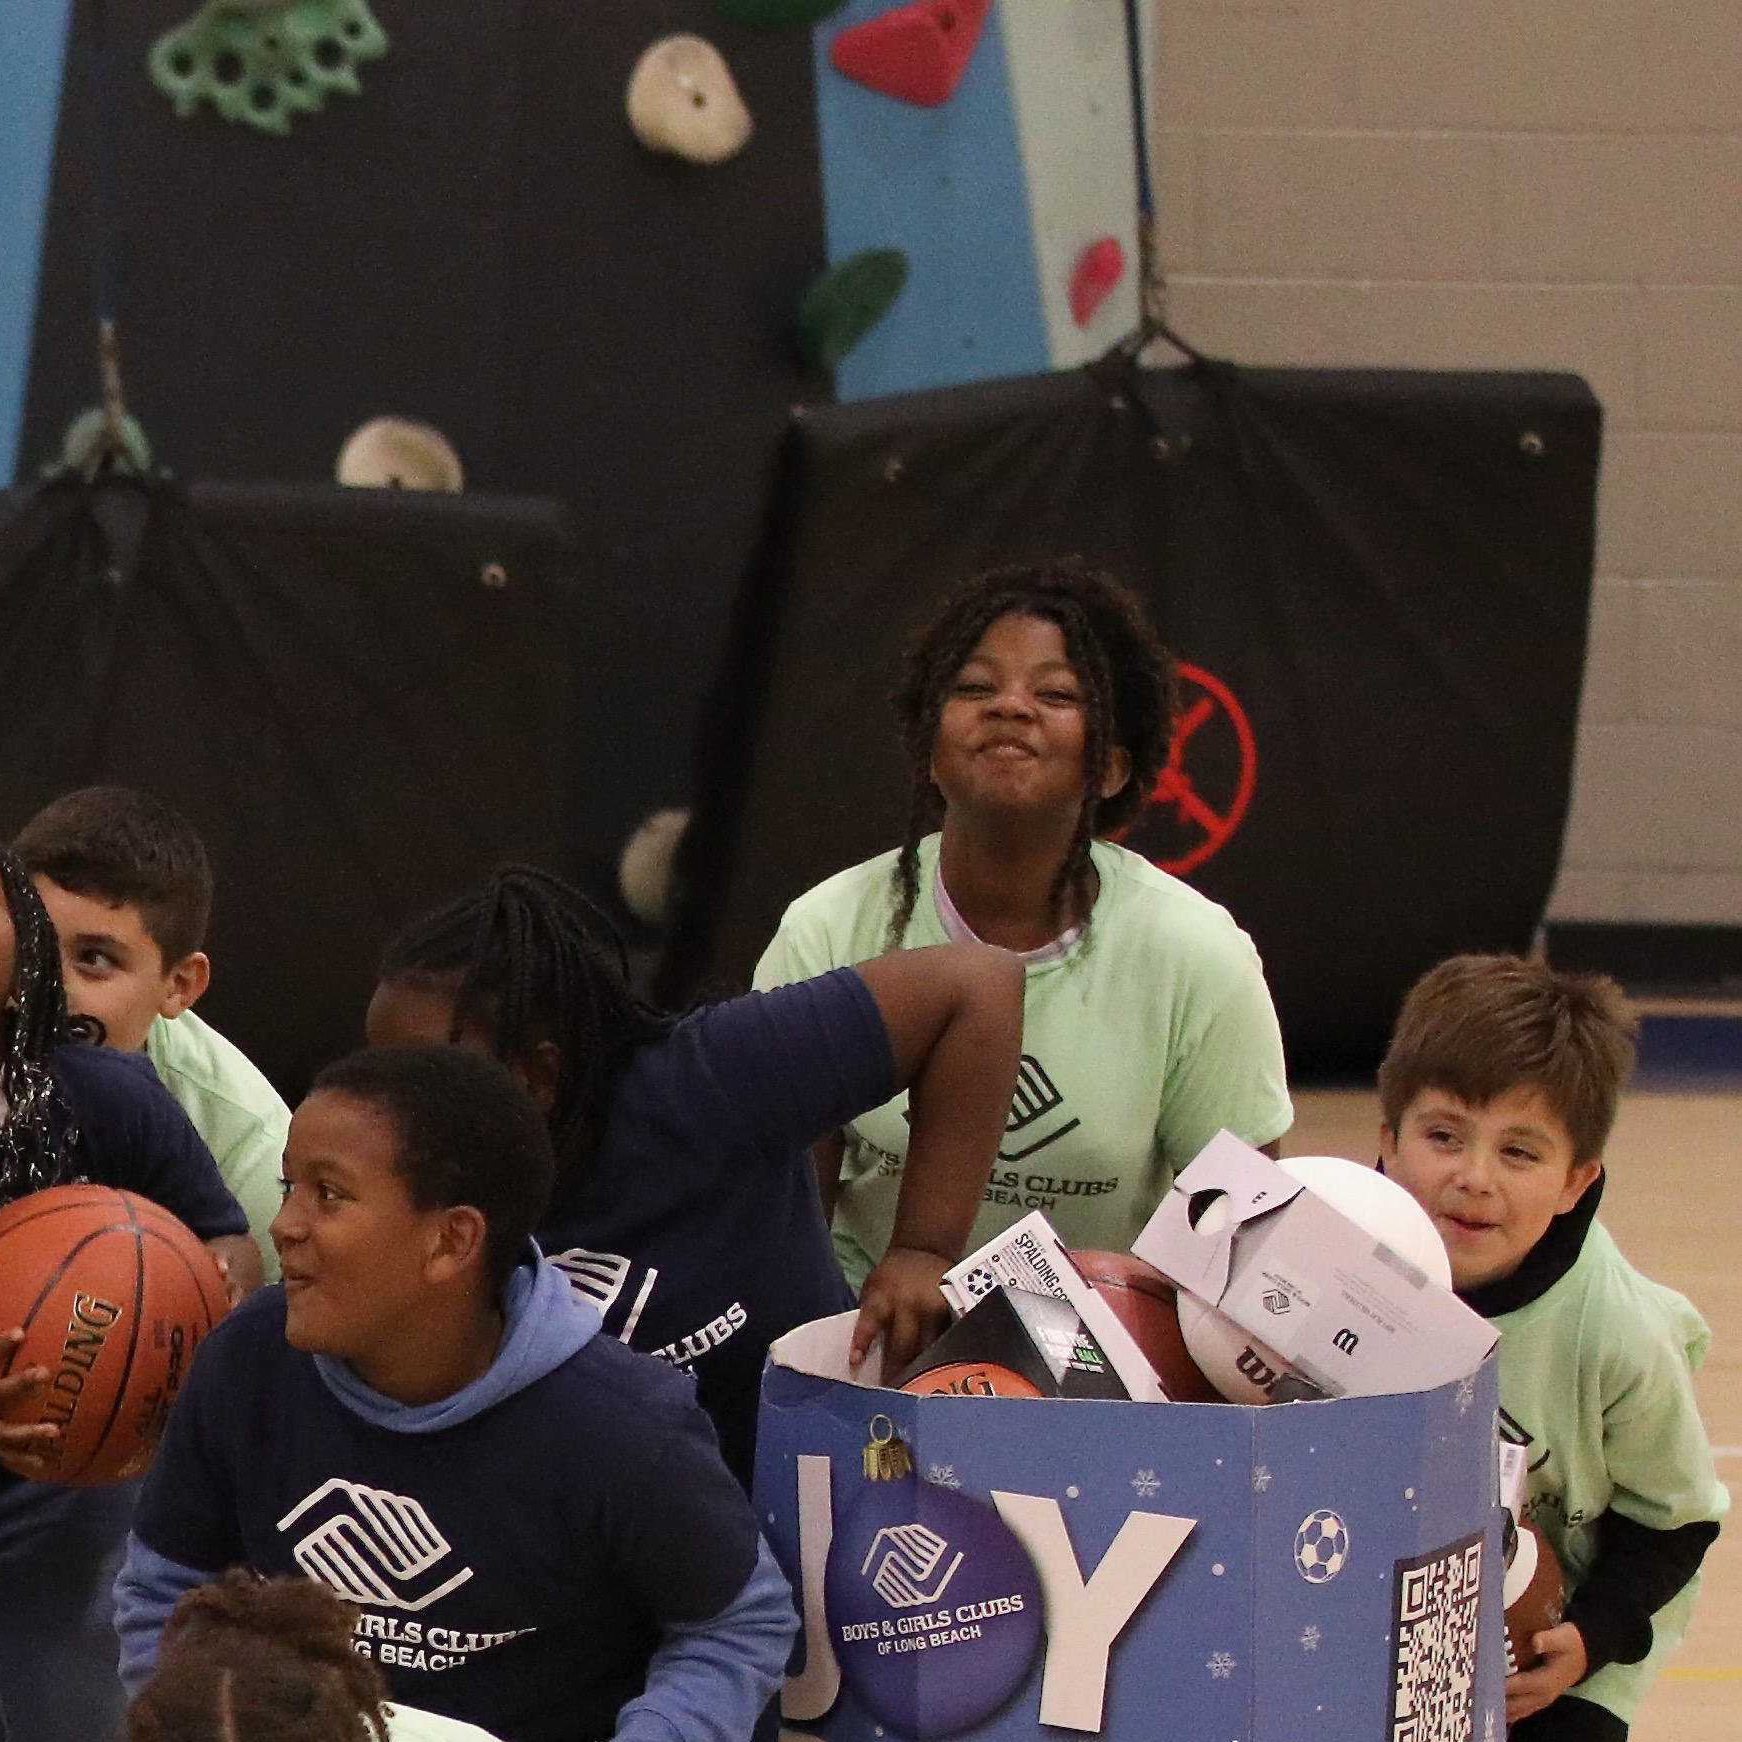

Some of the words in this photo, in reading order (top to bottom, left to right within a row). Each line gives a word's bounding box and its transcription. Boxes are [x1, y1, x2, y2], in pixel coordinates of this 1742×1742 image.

[352, 1612, 423, 1645] IRLS
[841, 1620, 880, 1642] BOYS
[881, 1619, 896, 1637] &
[896, 1609, 952, 1636] GIRLS
[955, 1594, 1024, 1624] CLUBS
[877, 1640, 893, 1656] OF
[894, 1636, 927, 1653] LONG
[929, 1624, 983, 1648] BEACH
